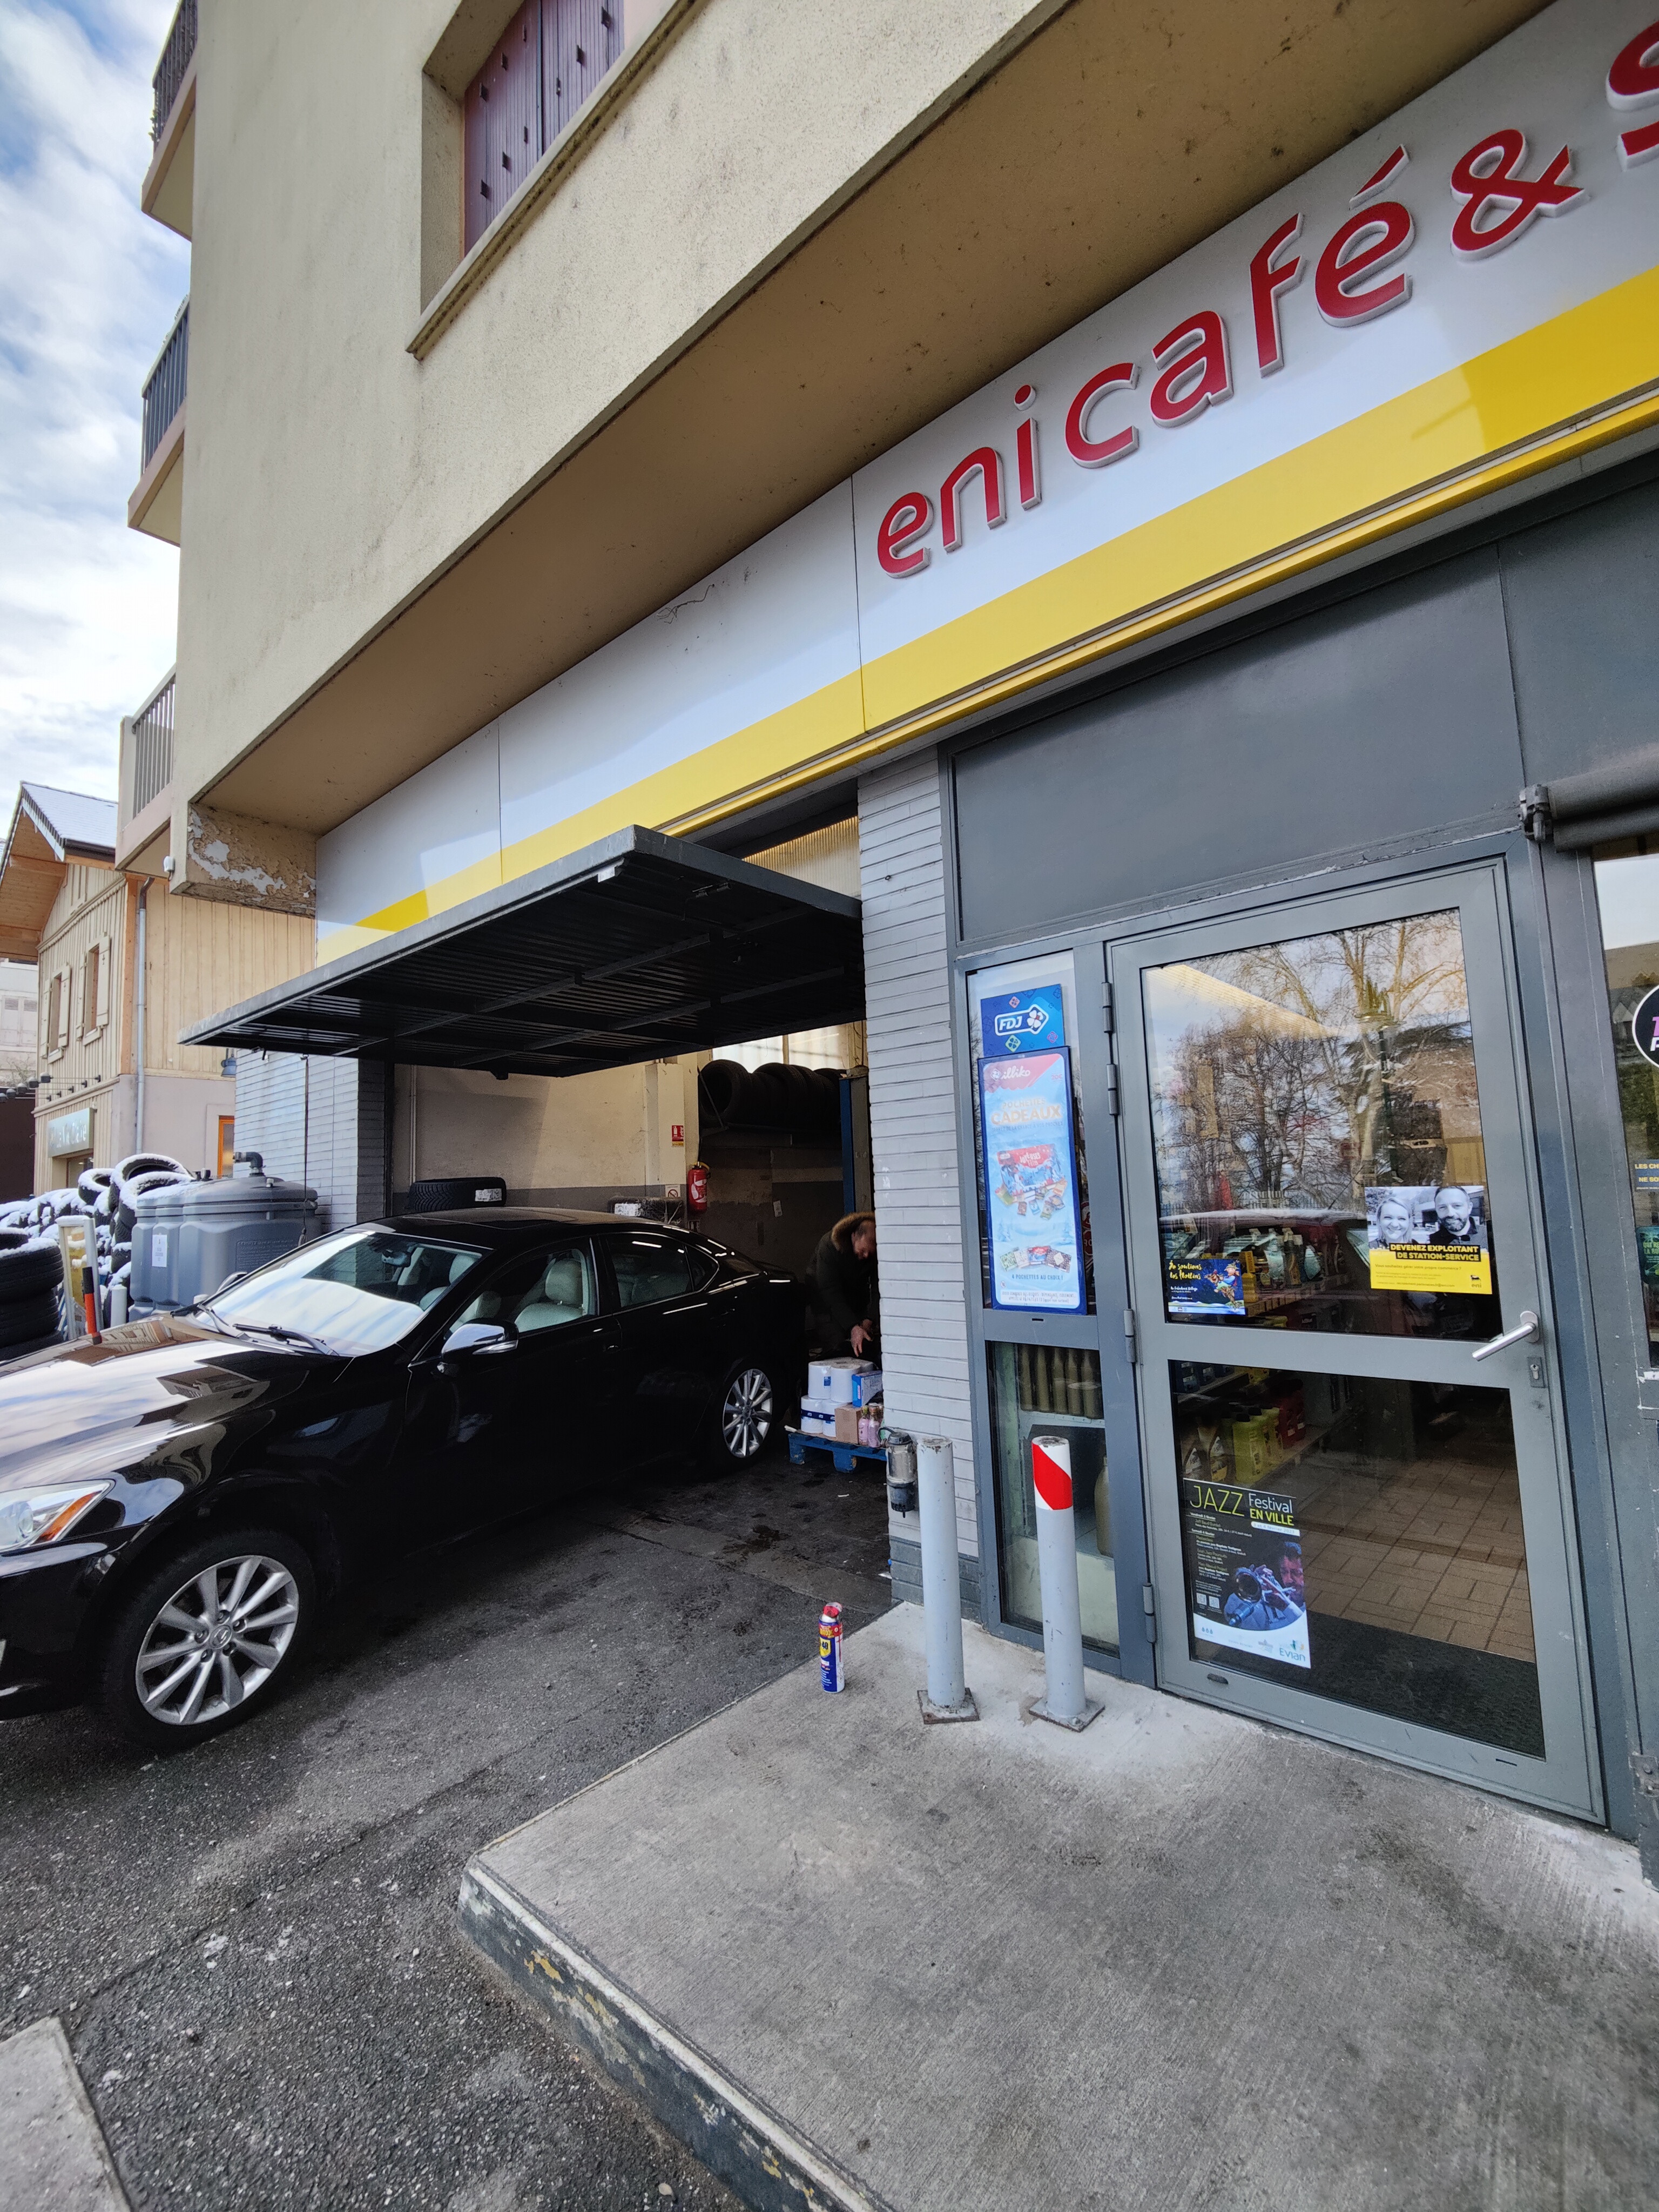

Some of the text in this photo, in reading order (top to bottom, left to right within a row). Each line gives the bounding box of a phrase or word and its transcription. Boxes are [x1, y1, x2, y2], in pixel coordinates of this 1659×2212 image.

[1450, 127, 1589, 261] &
[999, 1015, 1023, 1031] FDJ
[1001, 1065, 1031, 1080] illiko
[1002, 1097, 1046, 1109] POCHETTES
[991, 1104, 1062, 1125] CADEAUX
[1020, 1152, 1041, 1164] JOYEUSES
[1427, 1244, 1479, 1252] EXPLOITANT
[1409, 1252, 1479, 1261] STATION-SERVICE
[1177, 1263, 1202, 1271] soutiens
[1190, 1485, 1244, 1516] JAZZ
[1249, 1493, 1293, 1513] Festival
[1250, 1508, 1294, 1526] EN VILLE
[1279, 1648, 1306, 1662] Evian
